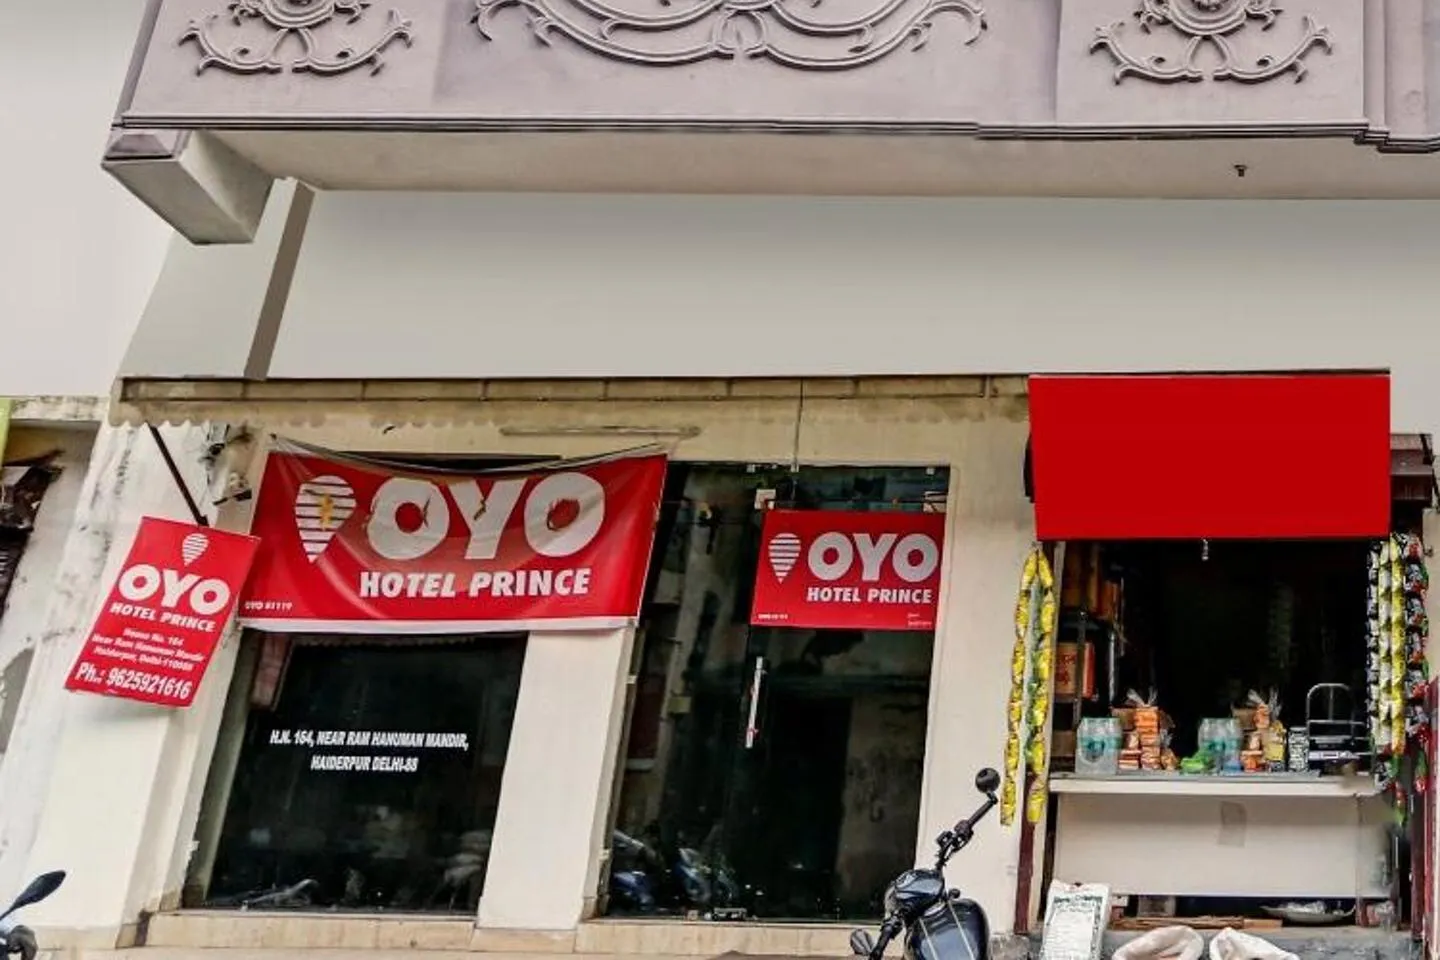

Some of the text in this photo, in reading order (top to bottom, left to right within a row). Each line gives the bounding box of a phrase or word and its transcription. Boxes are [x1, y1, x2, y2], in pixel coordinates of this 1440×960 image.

[366, 472, 605, 560] OYO
[808, 531, 939, 582] OYO
[118, 564, 231, 615] OYO
[360, 568, 592, 598] HOTEL PRINCE
[807, 587, 932, 604] HOTEL PRINCE
[110, 602, 217, 633] HOTEL PRINCE
[92, 633, 113, 644] Near
[106, 667, 193, 700] 9625921616
[316, 730, 346, 746] NEAR
[346, 731, 371, 746] RAM
[371, 731, 425, 748] HANUMAN
[310, 754, 371, 771] HAIDERPUR
